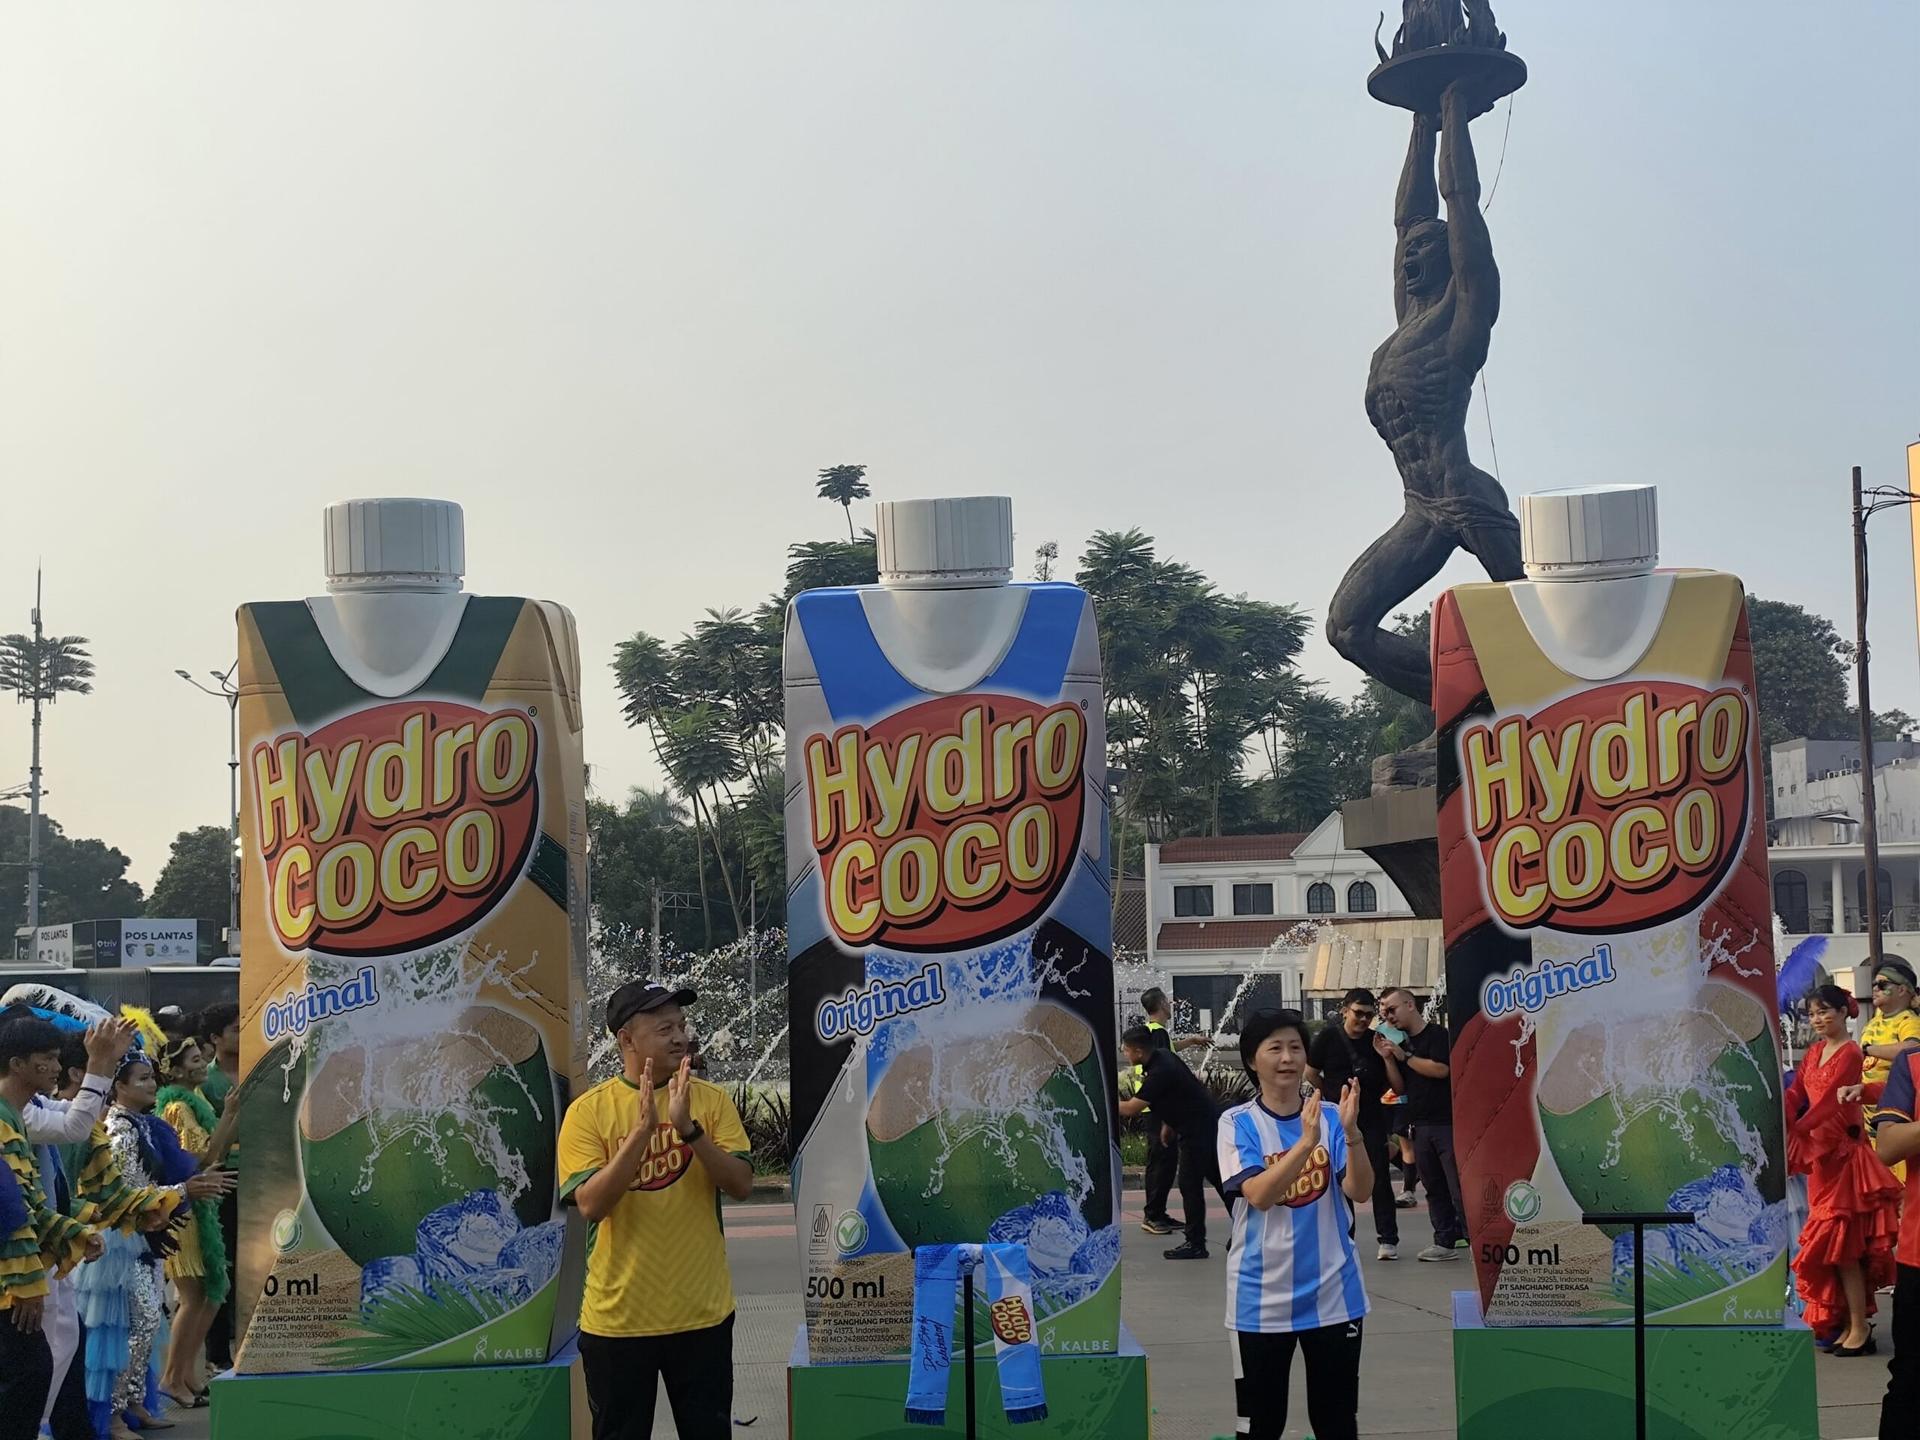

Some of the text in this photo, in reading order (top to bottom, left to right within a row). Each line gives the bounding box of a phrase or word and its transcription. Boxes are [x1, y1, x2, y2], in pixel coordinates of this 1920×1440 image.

[807, 705, 1081, 843] Hydro
[1465, 692, 1743, 832] Hydro
[253, 710, 530, 849] Hydro
[125, 931, 194, 940] POS LANTAS
[1485, 945, 1614, 1016] Original
[266, 968, 377, 1037] Original
[819, 965, 943, 1037] Original
[1481, 1243, 1560, 1265] 500 ml
[286, 1273, 319, 1296] ml
[806, 1275, 885, 1299] 500 ml
[256, 1315, 266, 1323] PT
[833, 1318, 878, 1326] SANGHIANG
[879, 1317, 913, 1325] PERKASA
[1005, 1296, 1031, 1342] Hydro
[493, 1347, 544, 1360] KALBE
[1061, 1339, 1110, 1352] KALBE
